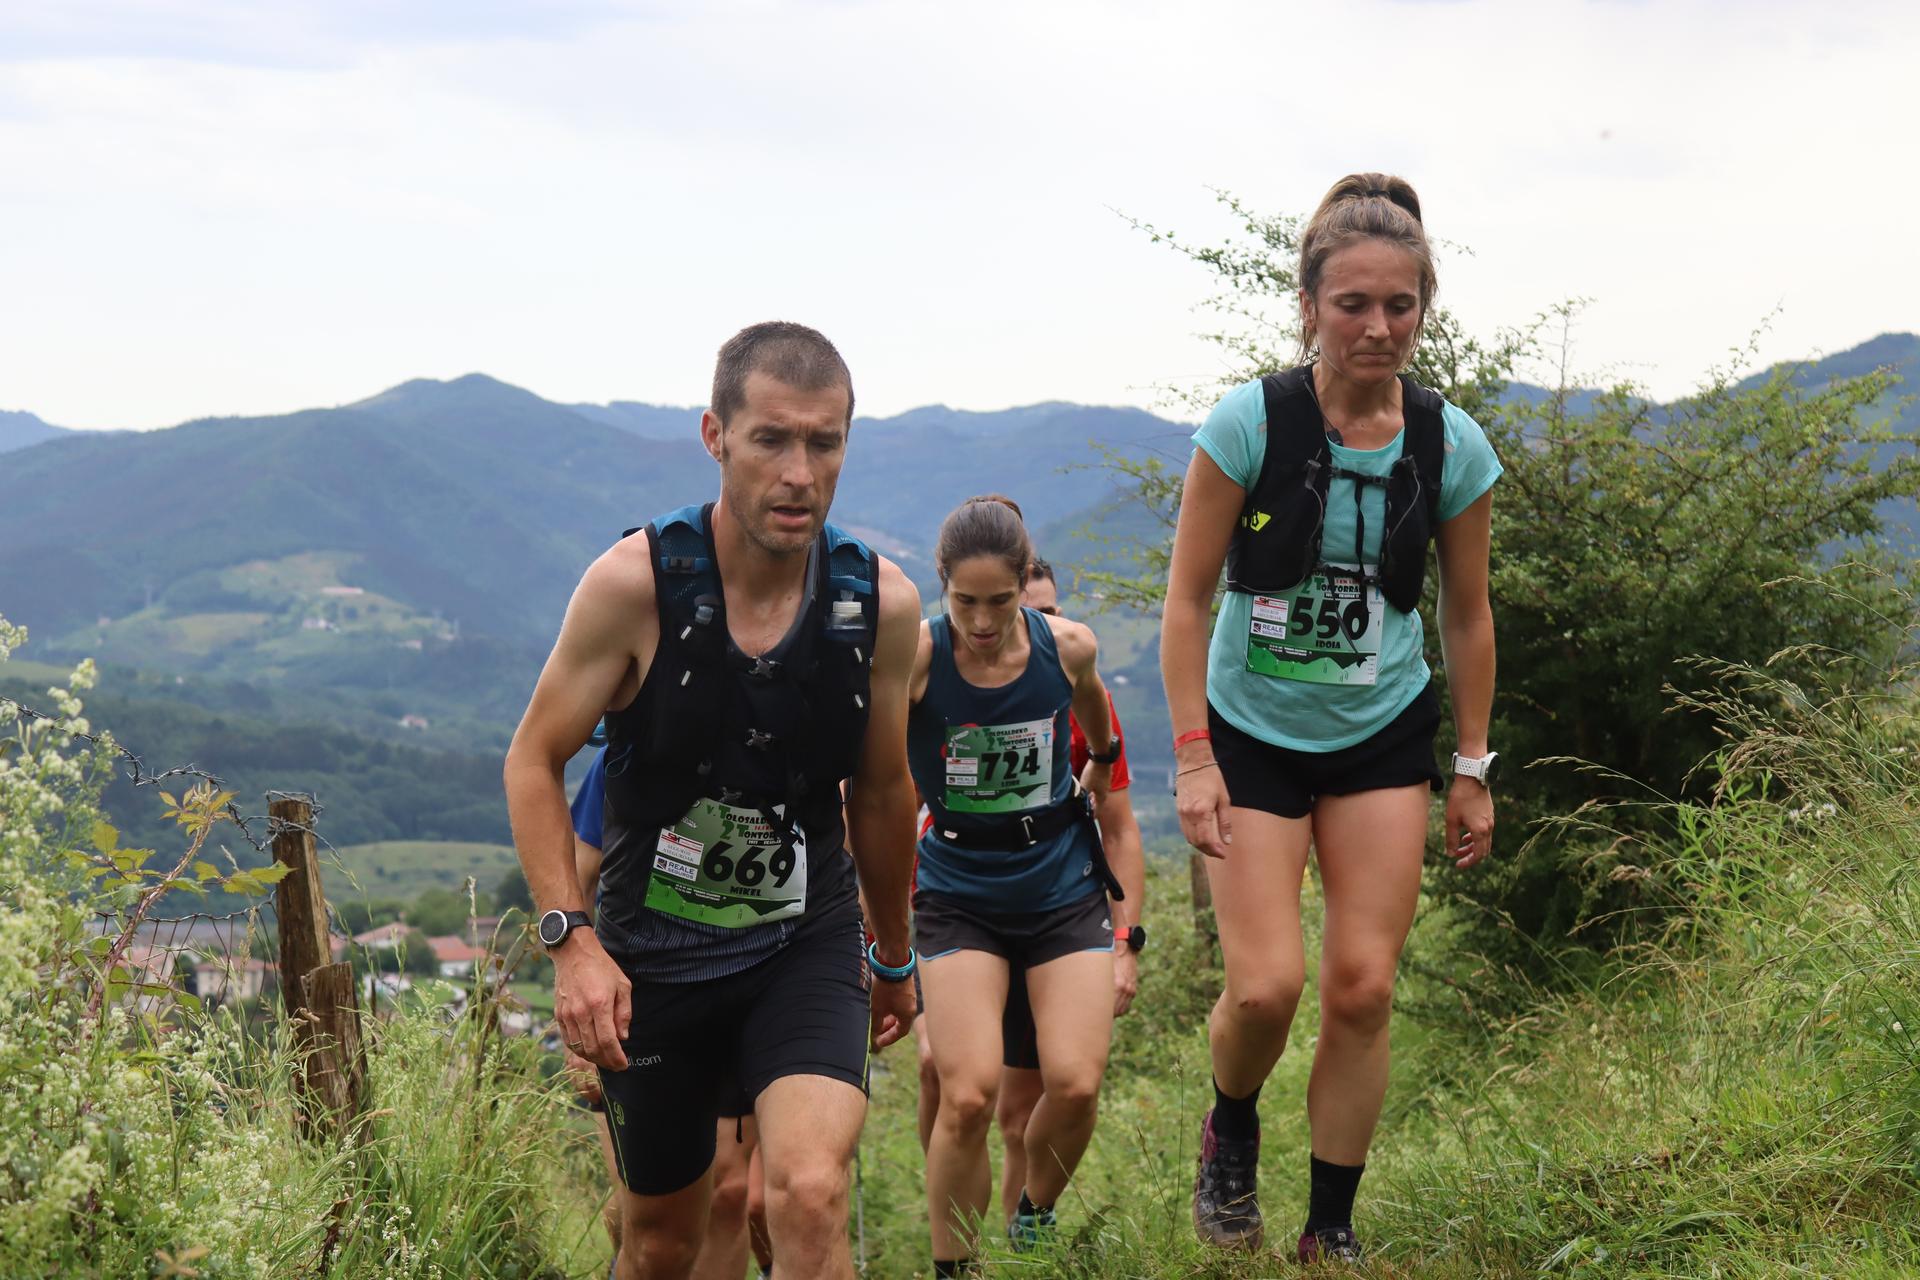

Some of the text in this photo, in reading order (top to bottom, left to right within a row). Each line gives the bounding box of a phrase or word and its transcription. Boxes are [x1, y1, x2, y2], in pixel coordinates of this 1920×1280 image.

[1291, 597, 1369, 640] 550
[1316, 640, 1341, 649] IDOIA
[981, 748, 1040, 782] 724
[720, 820, 735, 840] 2
[668, 862, 695, 875] REALE
[703, 840, 796, 889] 669
[730, 886, 761, 897] MIKEL
